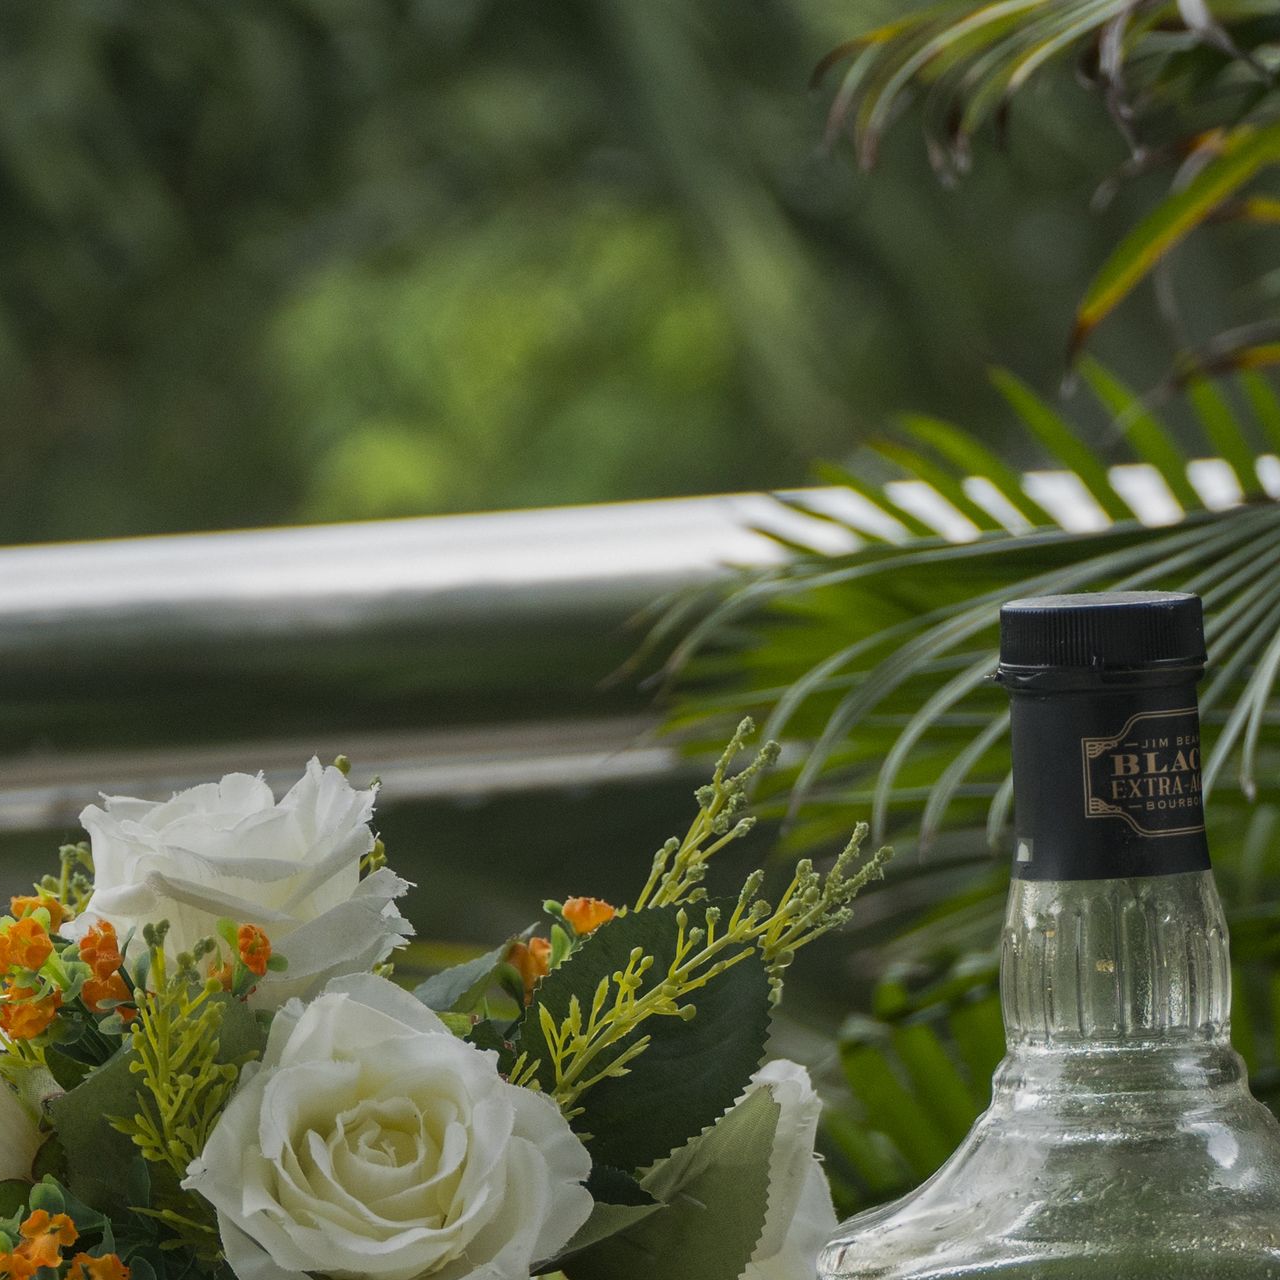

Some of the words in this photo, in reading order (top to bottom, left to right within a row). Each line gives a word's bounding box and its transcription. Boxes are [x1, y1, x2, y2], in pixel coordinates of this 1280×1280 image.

[1141, 737, 1169, 749] JIM
[1109, 747, 1200, 777] BLAC
[1146, 797, 1200, 811] BOURBO
